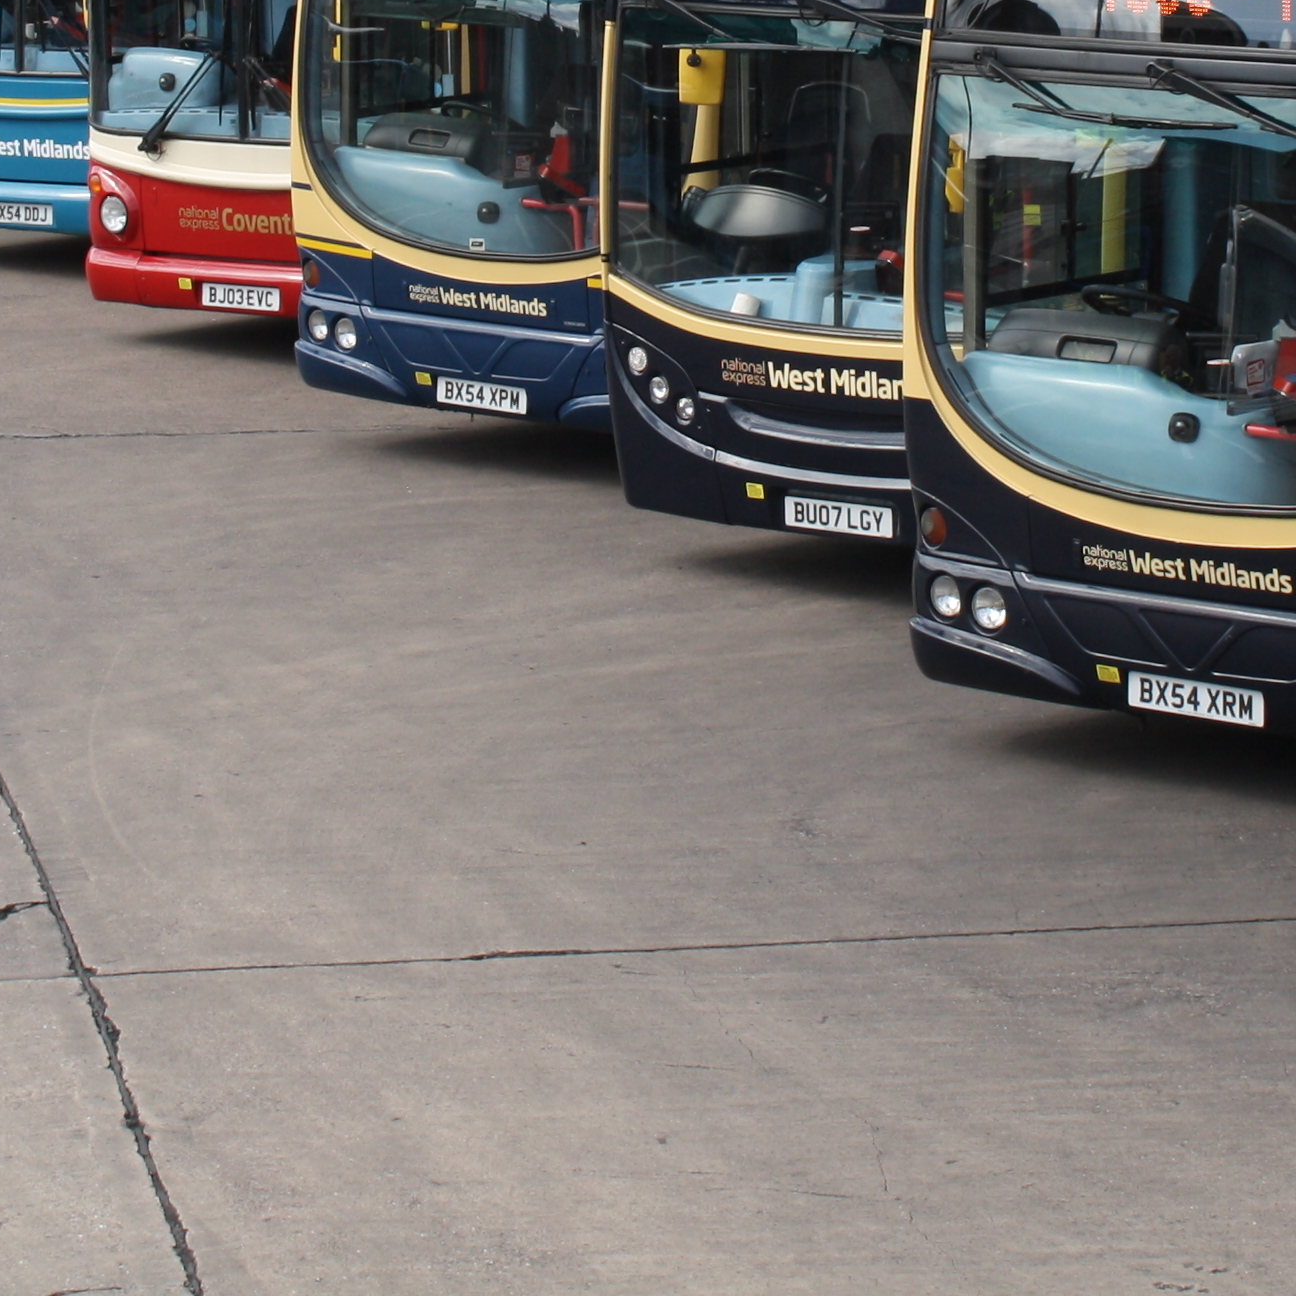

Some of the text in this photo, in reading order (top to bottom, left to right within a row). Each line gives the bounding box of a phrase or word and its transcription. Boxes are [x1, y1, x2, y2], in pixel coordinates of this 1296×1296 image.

[23, 138, 91, 160] Midlands
[24, 206, 48, 223] DDJ
[178, 205, 219, 219] national
[179, 218, 220, 231] express
[208, 286, 274, 308] BJ03 EVC
[408, 283, 439, 296] national
[409, 292, 440, 304] express
[439, 286, 547, 317] West Midlands
[721, 358, 766, 374] national
[722, 370, 767, 387] express
[767, 361, 826, 394] West
[444, 380, 521, 410] BX54 XPM
[793, 501, 884, 533] BU07 LGY
[1082, 544, 1128, 561] national
[1083, 555, 1129, 572] express
[1128, 549, 1293, 594] West Midlands
[1139, 676, 1253, 720] BX54 XRM
